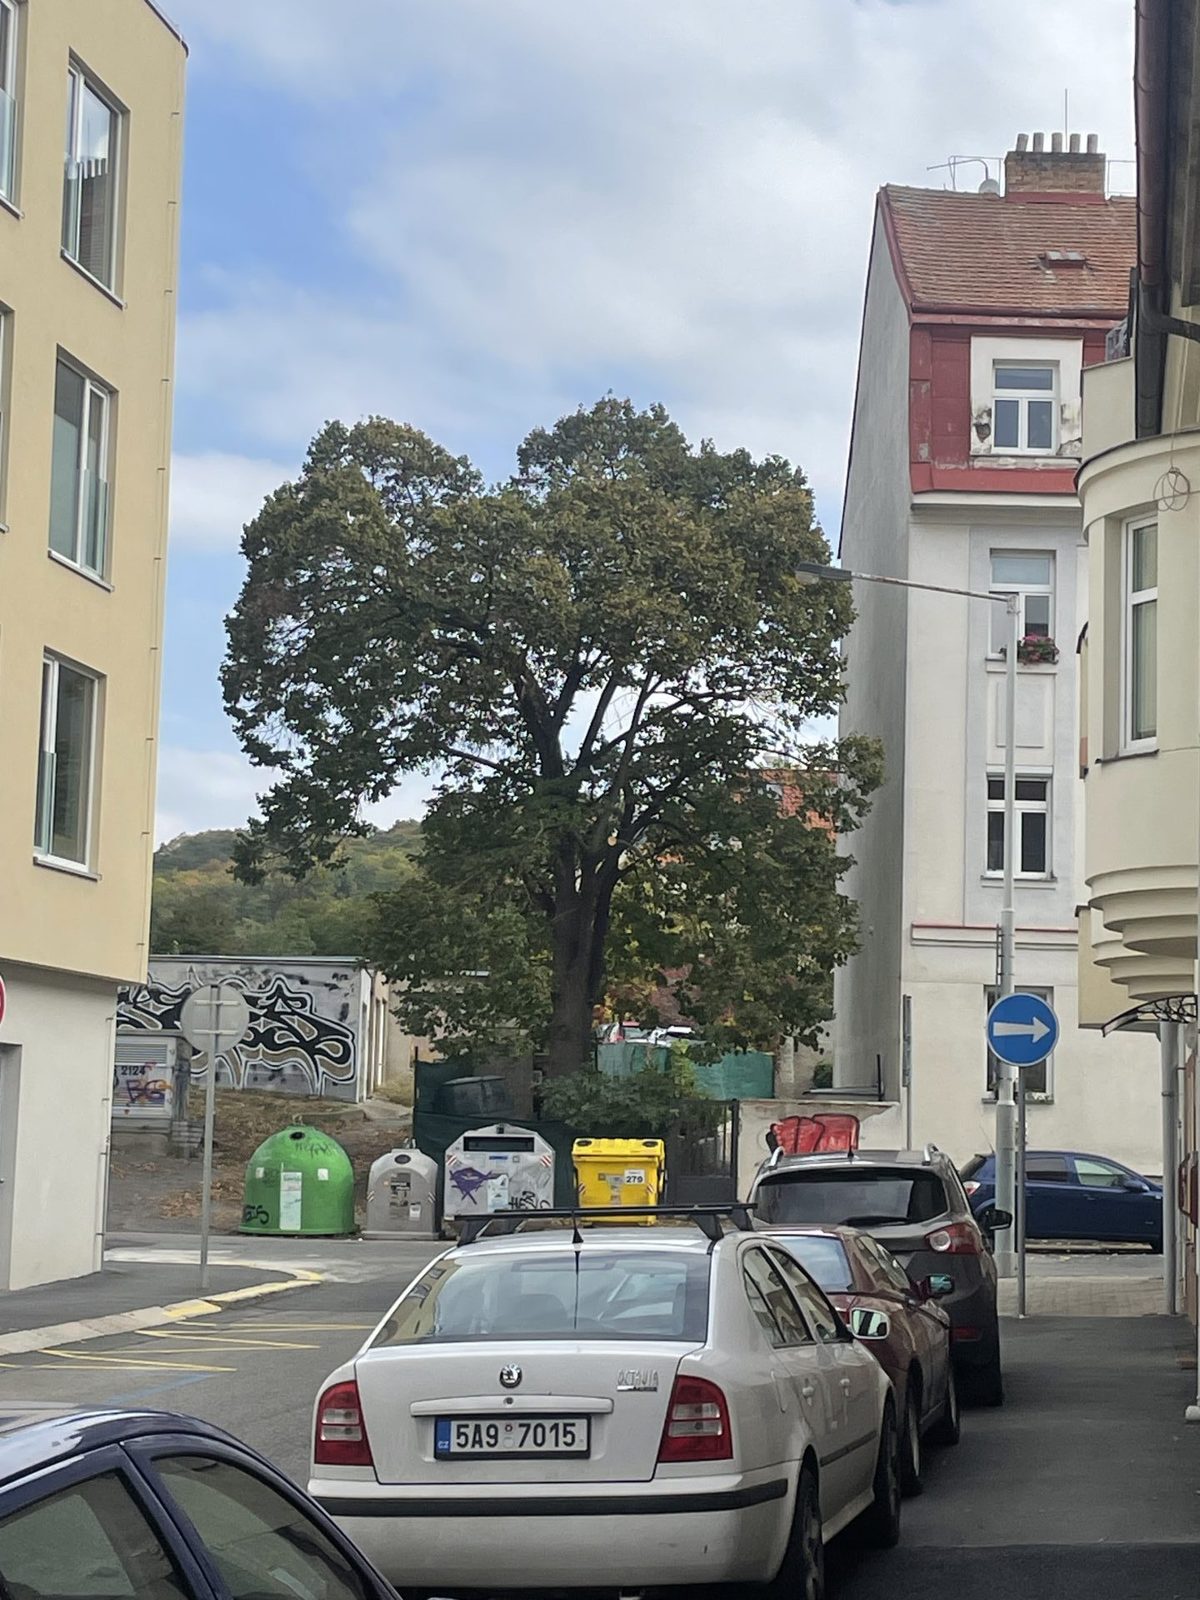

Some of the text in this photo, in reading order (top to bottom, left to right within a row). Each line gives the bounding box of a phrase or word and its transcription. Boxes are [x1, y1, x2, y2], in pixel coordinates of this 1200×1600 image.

[121, 1065, 146, 1076] 2124
[617, 1369, 659, 1386] OCTAVIA
[437, 1422, 577, 1449] CZ 5A9 7015
